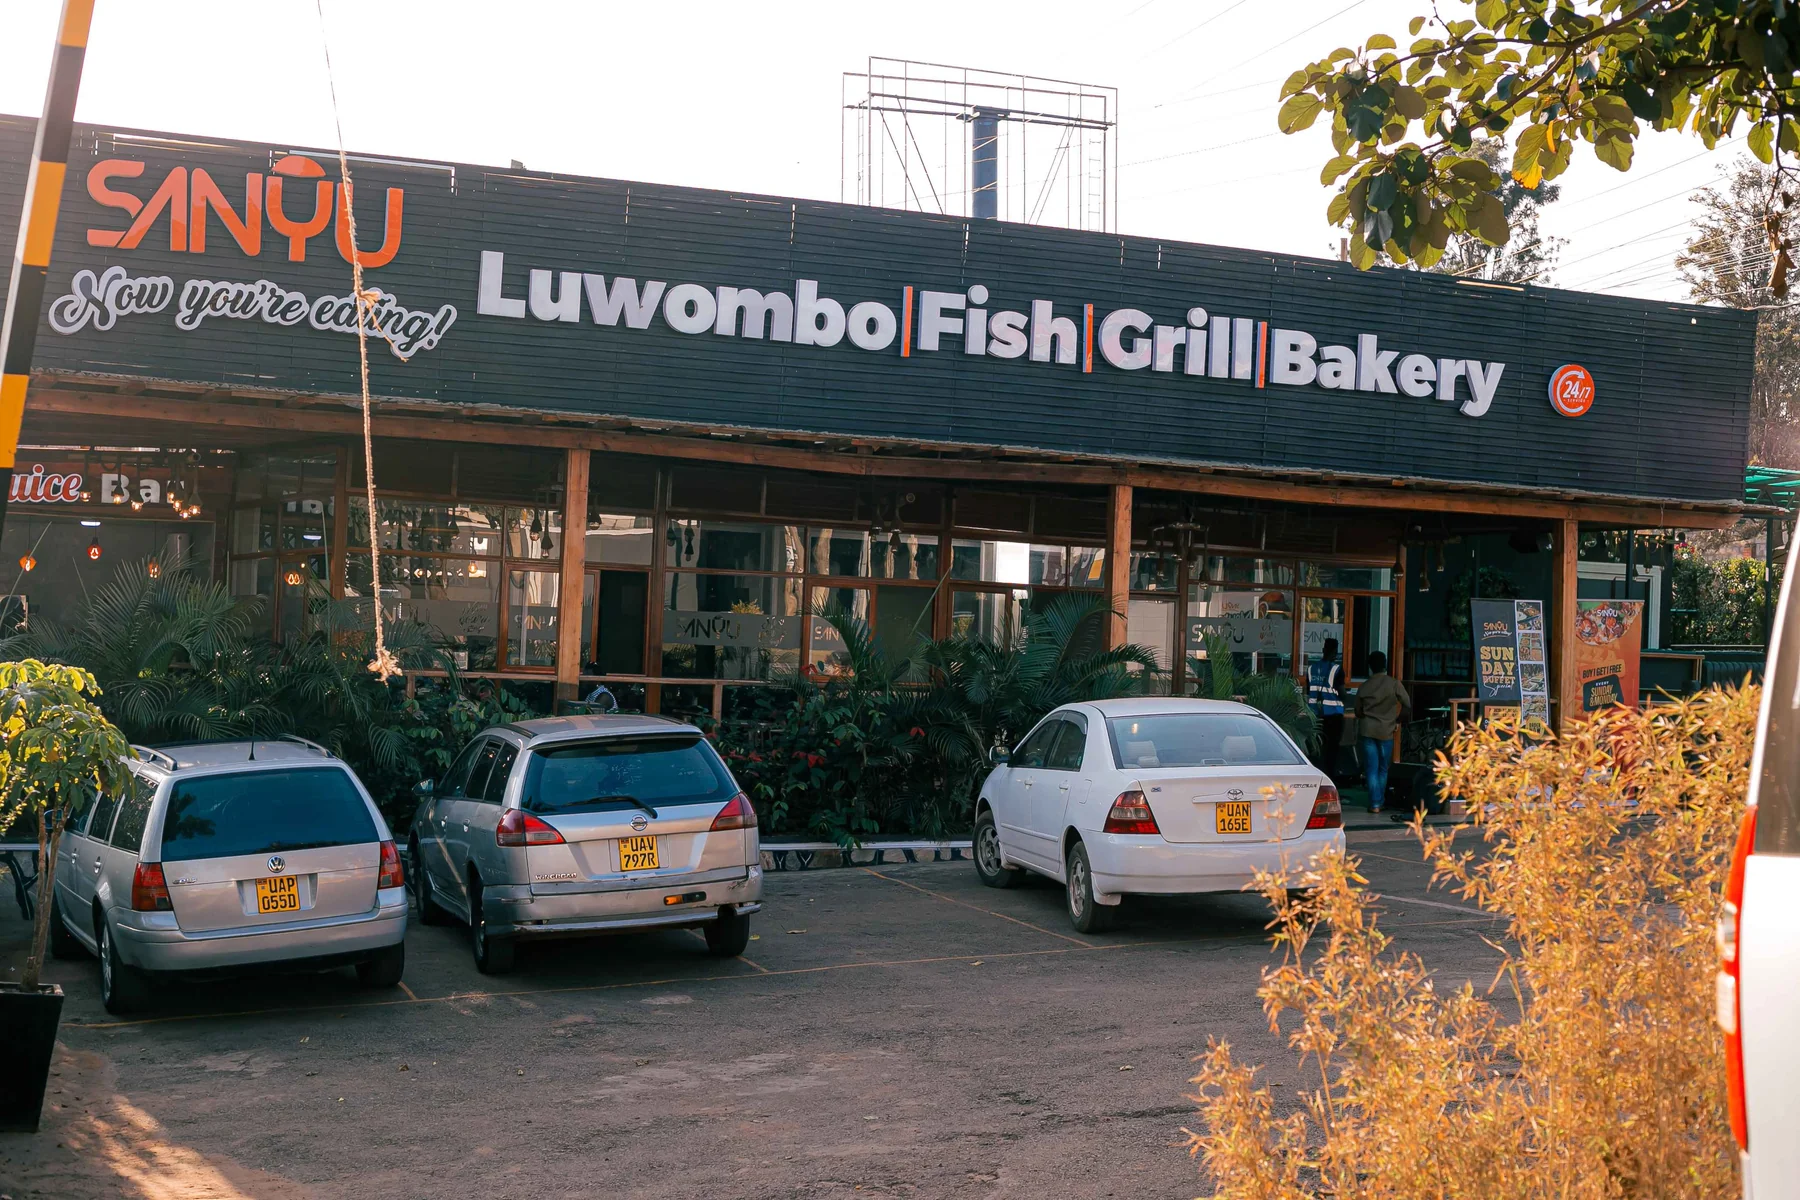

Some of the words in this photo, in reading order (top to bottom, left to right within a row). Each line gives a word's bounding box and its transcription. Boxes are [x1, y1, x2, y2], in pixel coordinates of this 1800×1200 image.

[87, 155, 404, 268] SANYU
[50, 266, 173, 334] Now
[175, 280, 308, 330] you're
[477, 250, 897, 351] Luwombo
[918, 284, 1077, 365] Fish
[1100, 307, 1254, 380] Grill
[1270, 328, 1505, 417] Bakery
[1563, 380, 1591, 398] 24/7
[7, 463, 83, 503] uice
[1480, 645, 1514, 661] SUN
[1481, 661, 1515, 675] DAY
[1582, 669, 1593, 679] BUY
[1596, 666, 1606, 676] GET
[1609, 663, 1622, 673] FREE
[1482, 675, 1516, 684] BUFFET
[1227, 803, 1249, 817] UAN
[1220, 818, 1249, 831] 165E
[630, 836, 654, 852] UAV
[623, 852, 656, 868] 797R
[268, 877, 295, 893] UAP
[261, 893, 297, 911] 055D
